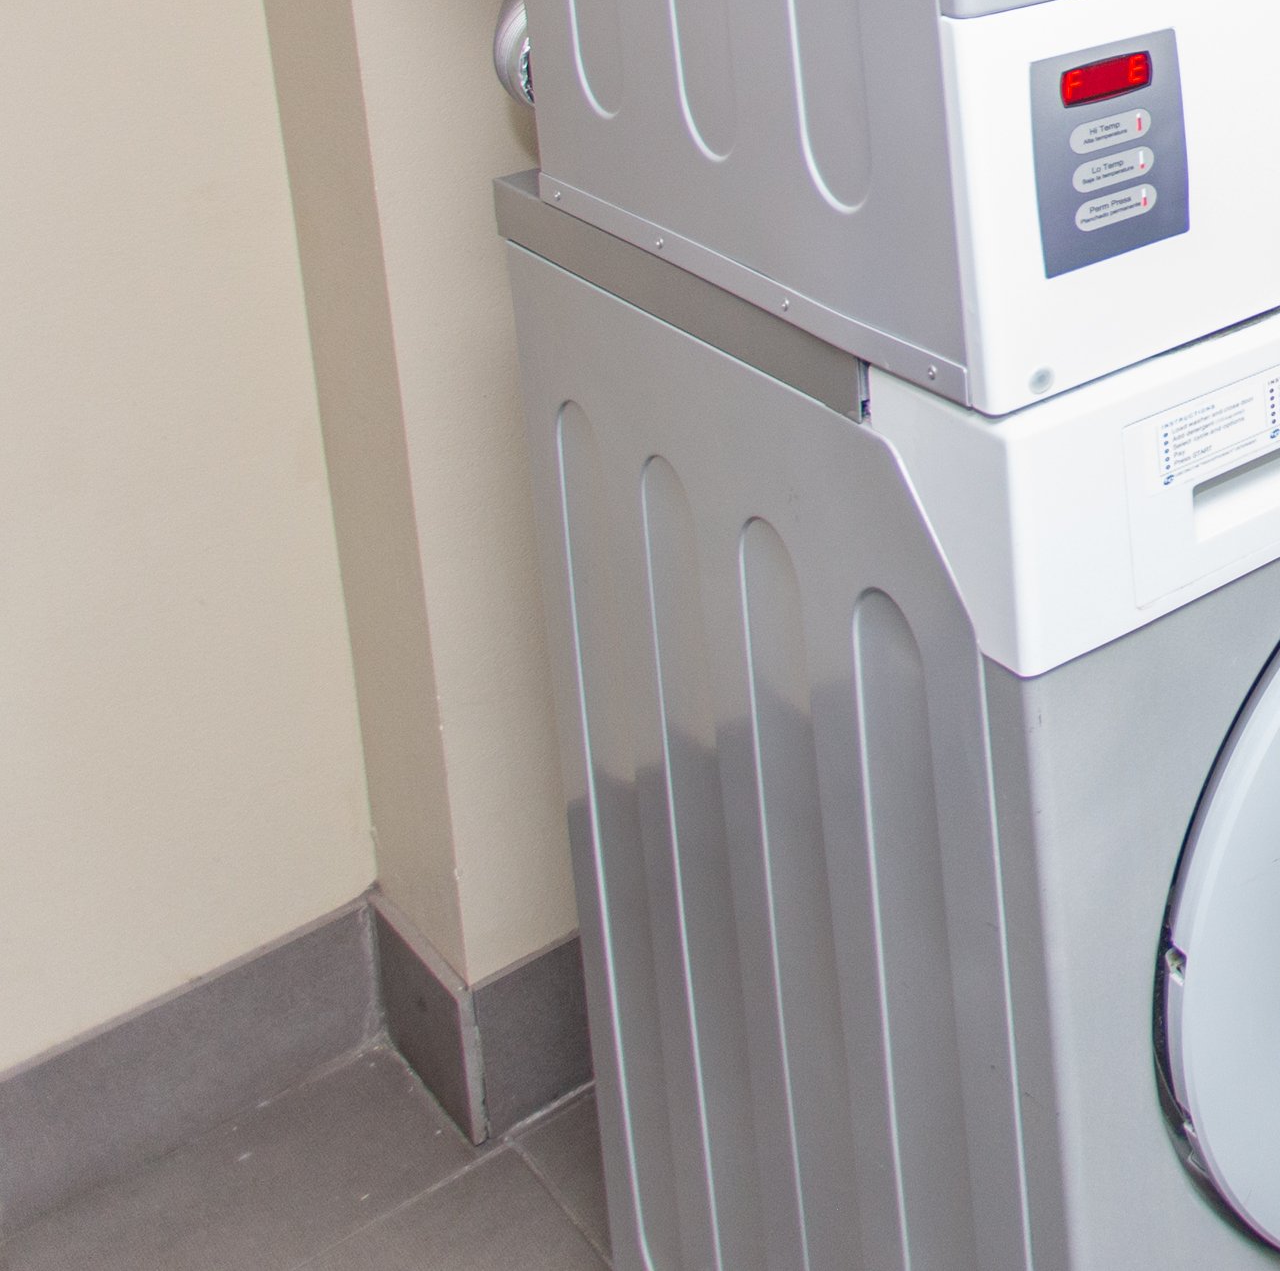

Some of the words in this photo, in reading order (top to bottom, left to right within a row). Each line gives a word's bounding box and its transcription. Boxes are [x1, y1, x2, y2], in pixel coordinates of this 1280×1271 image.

[1099, 122, 1120, 132] Temp
[1103, 159, 1124, 171] Temp
[1089, 202, 1109, 213] Perm
[1111, 196, 1132, 207] Press
